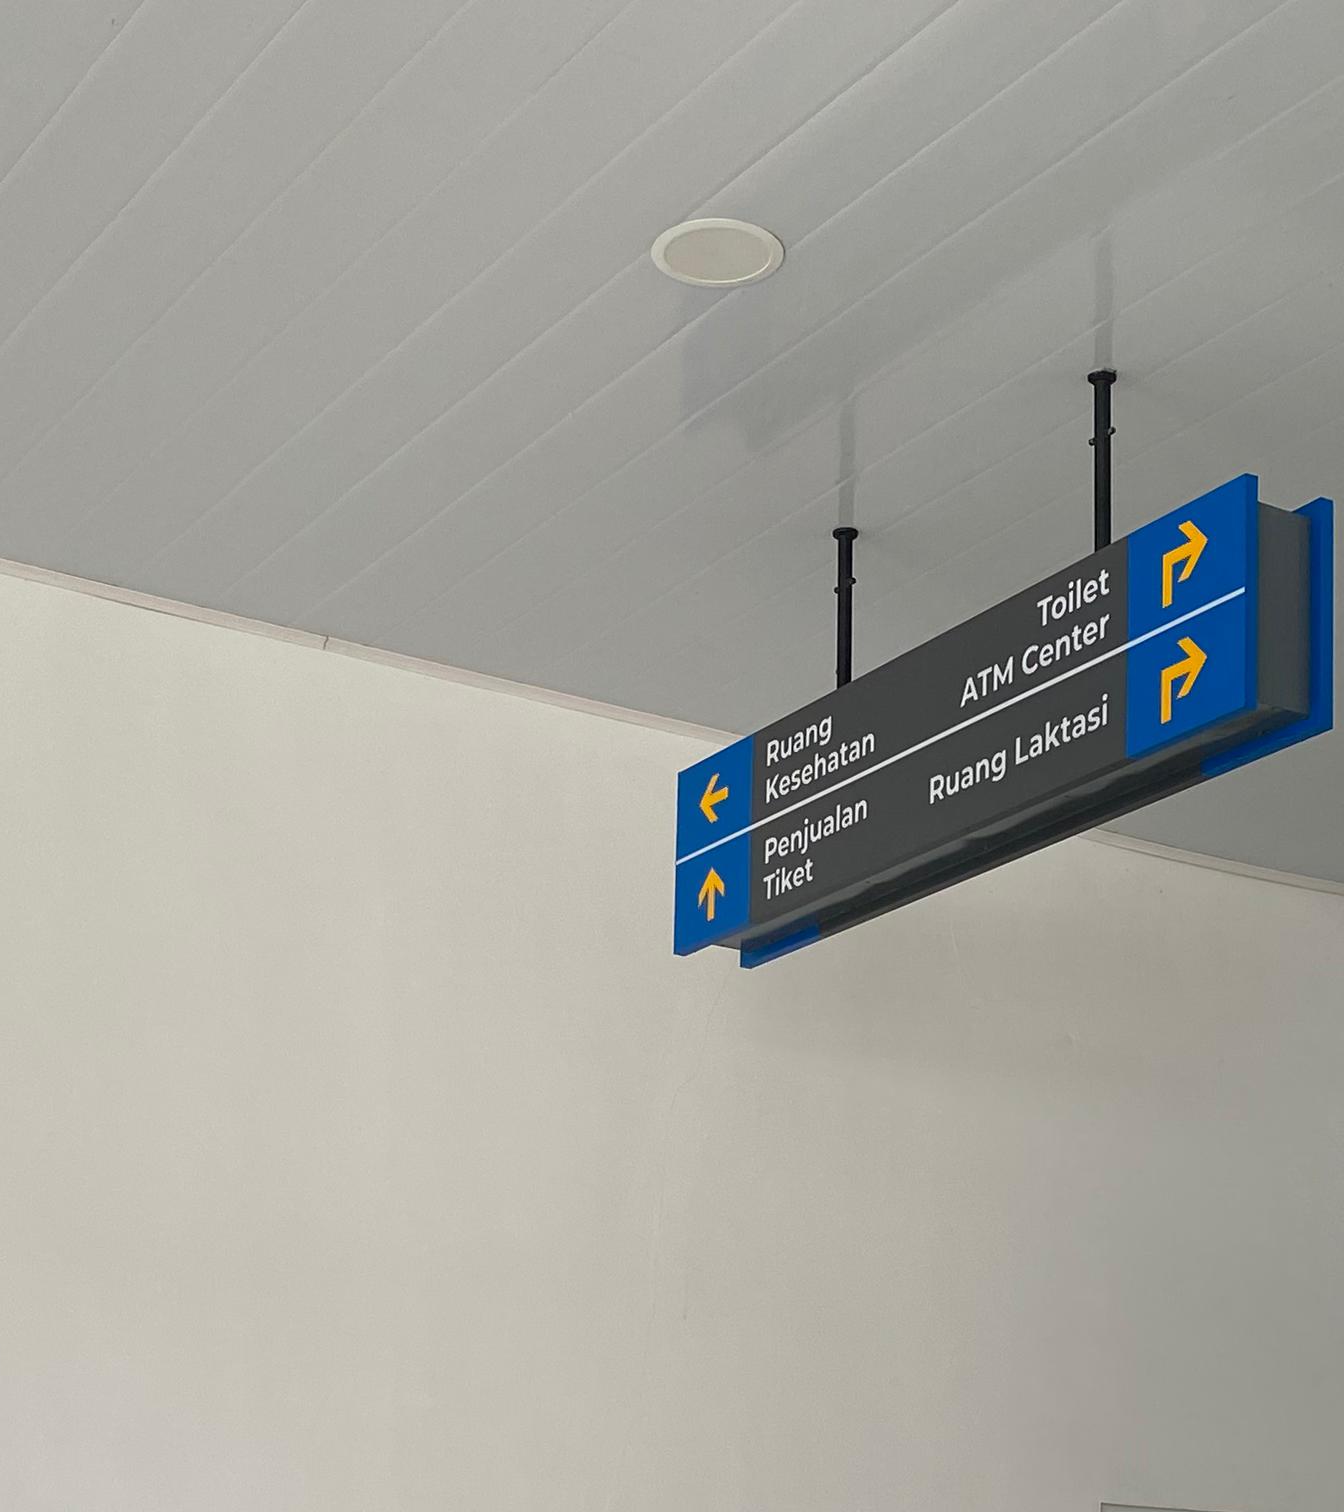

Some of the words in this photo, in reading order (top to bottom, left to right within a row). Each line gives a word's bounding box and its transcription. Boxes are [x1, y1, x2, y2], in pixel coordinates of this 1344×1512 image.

[1036, 569, 1110, 627] Toilet
[960, 655, 1014, 708] ATM
[1021, 613, 1110, 675] Center
[765, 733, 875, 804] Kesehatan
[766, 715, 832, 767] Ruang
[929, 749, 1007, 805] Ruang
[1015, 693, 1109, 765] Laktasi
[764, 799, 868, 865] Penjualan
[762, 858, 814, 900] Tiket
